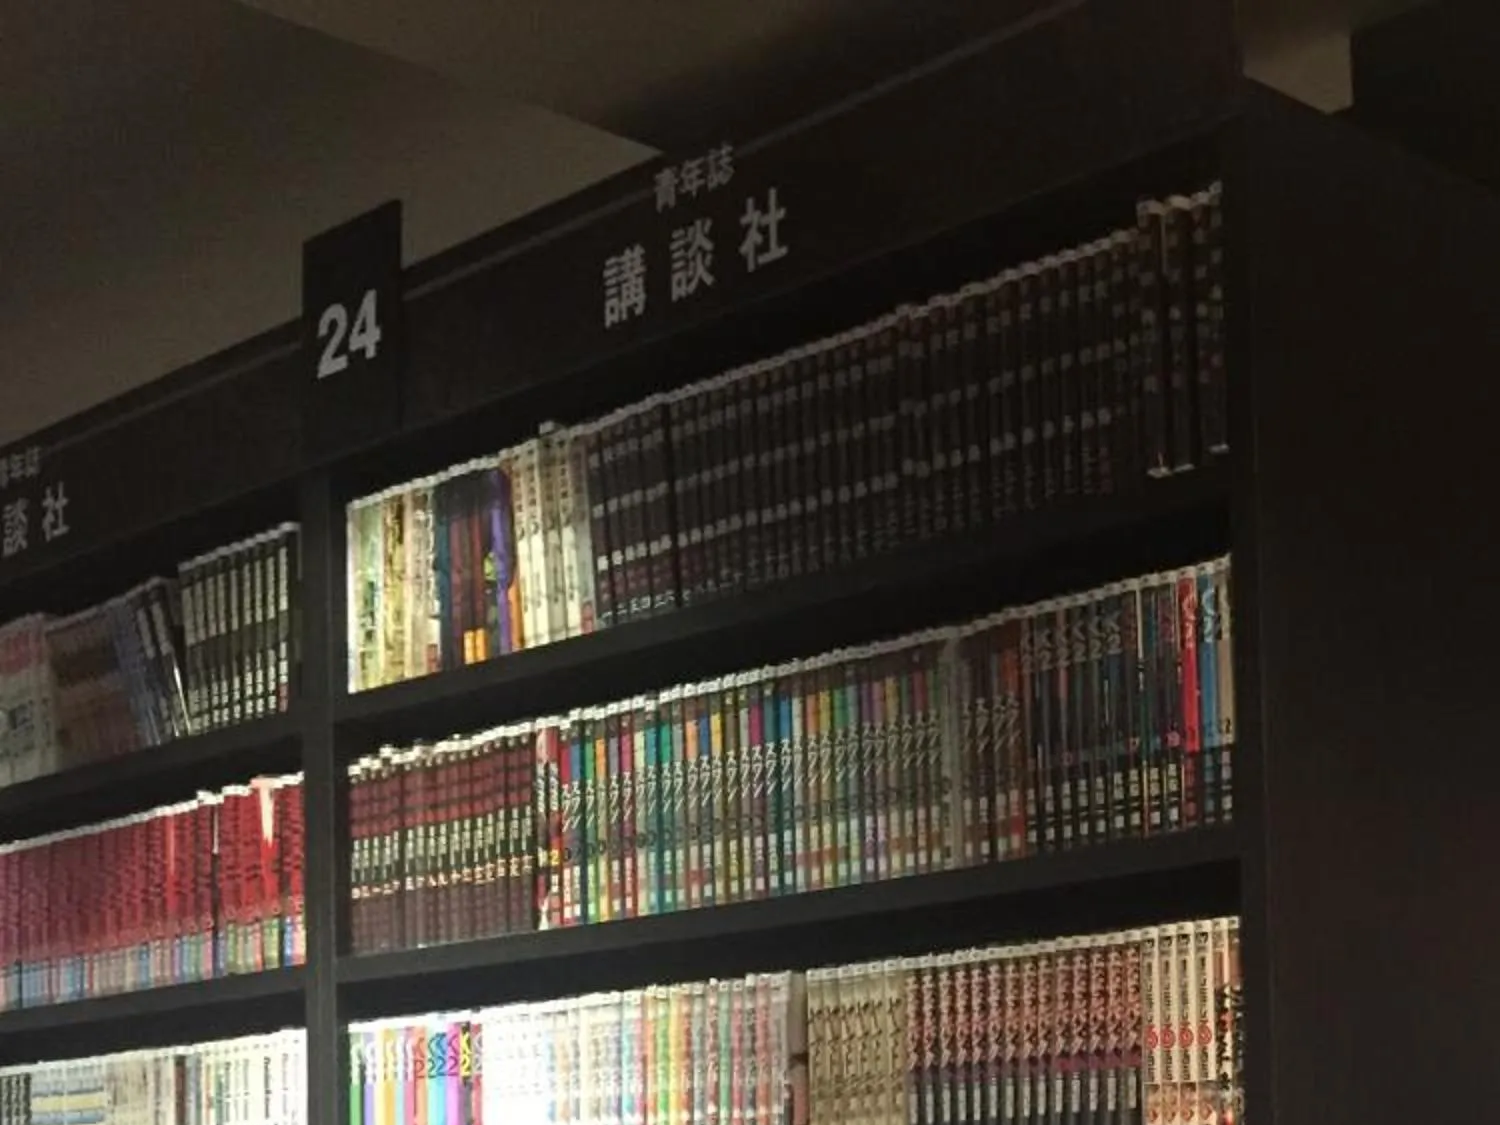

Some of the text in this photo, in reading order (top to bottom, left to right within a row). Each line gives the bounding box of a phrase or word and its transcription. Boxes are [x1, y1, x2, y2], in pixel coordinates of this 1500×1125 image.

[655, 142, 733, 213] 青年誌
[603, 186, 788, 328] 講談社
[317, 288, 381, 379] 24
